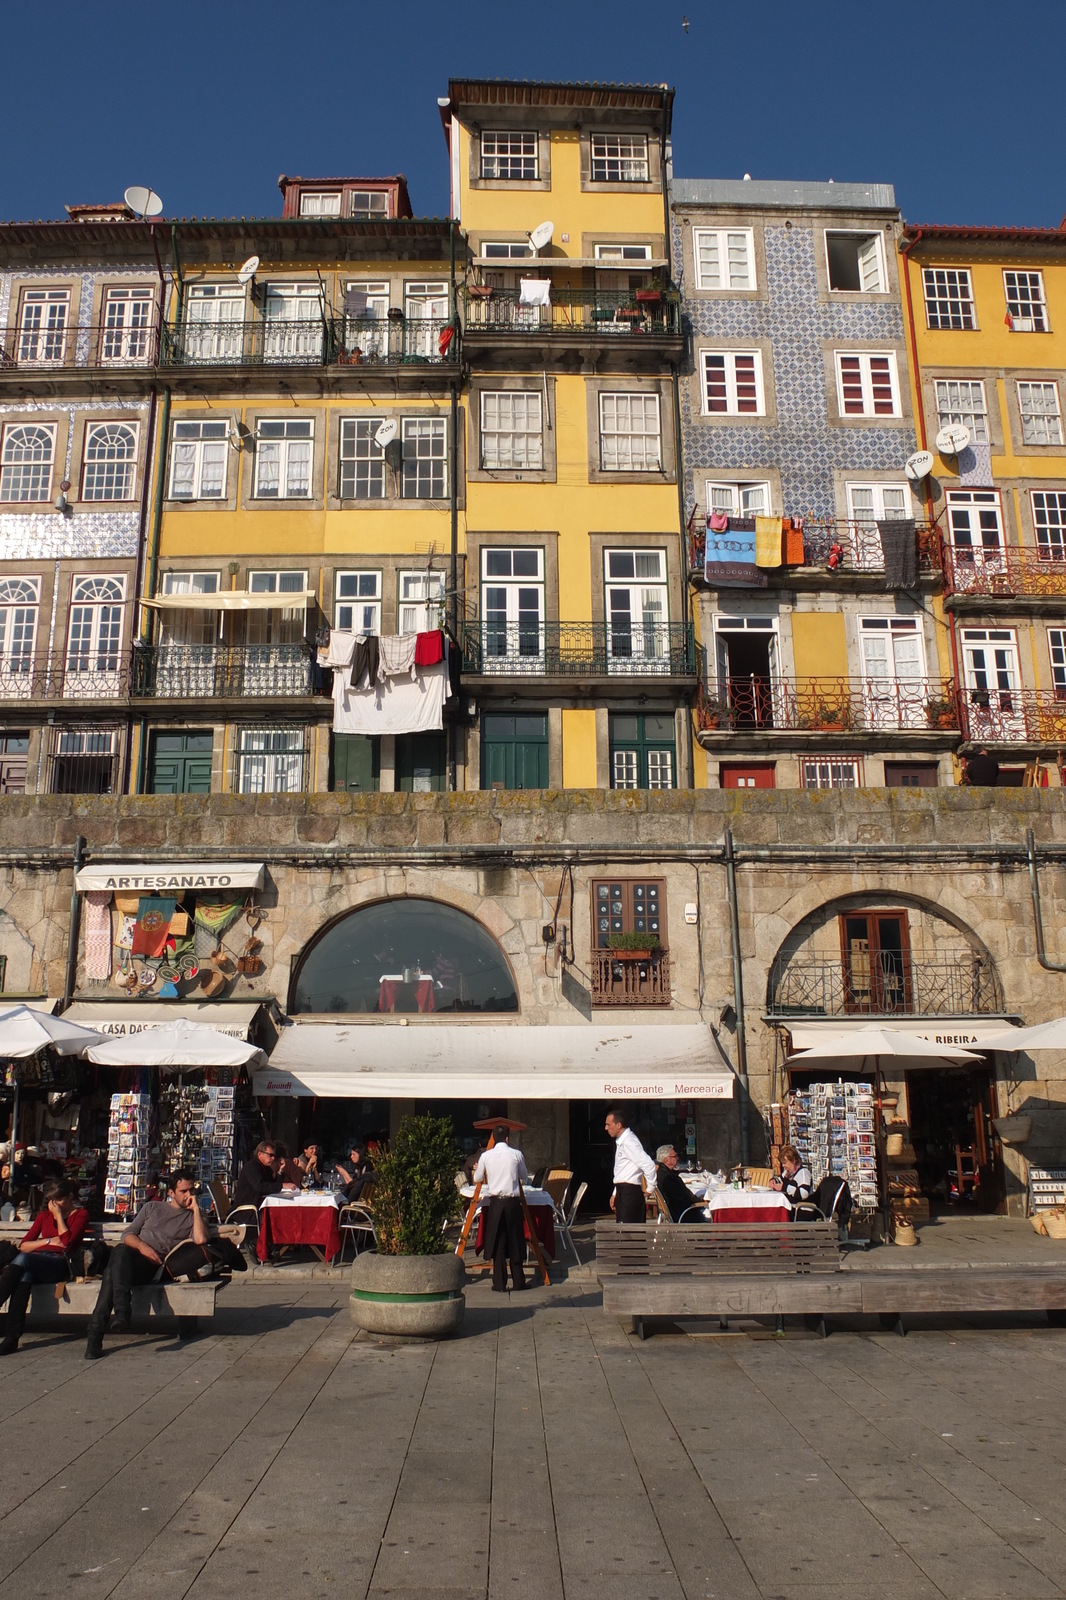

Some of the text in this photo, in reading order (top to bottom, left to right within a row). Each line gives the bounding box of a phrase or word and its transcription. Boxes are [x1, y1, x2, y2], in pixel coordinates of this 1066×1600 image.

[380, 424, 394, 434] ZON
[937, 434, 968, 447] instlsat
[105, 875, 232, 889] ARTESANATO
[102, 1023, 126, 1035] CASA
[935, 1035, 978, 1044] RIBEIRA
[604, 1084, 724, 1094] Restaurante Mercearia
